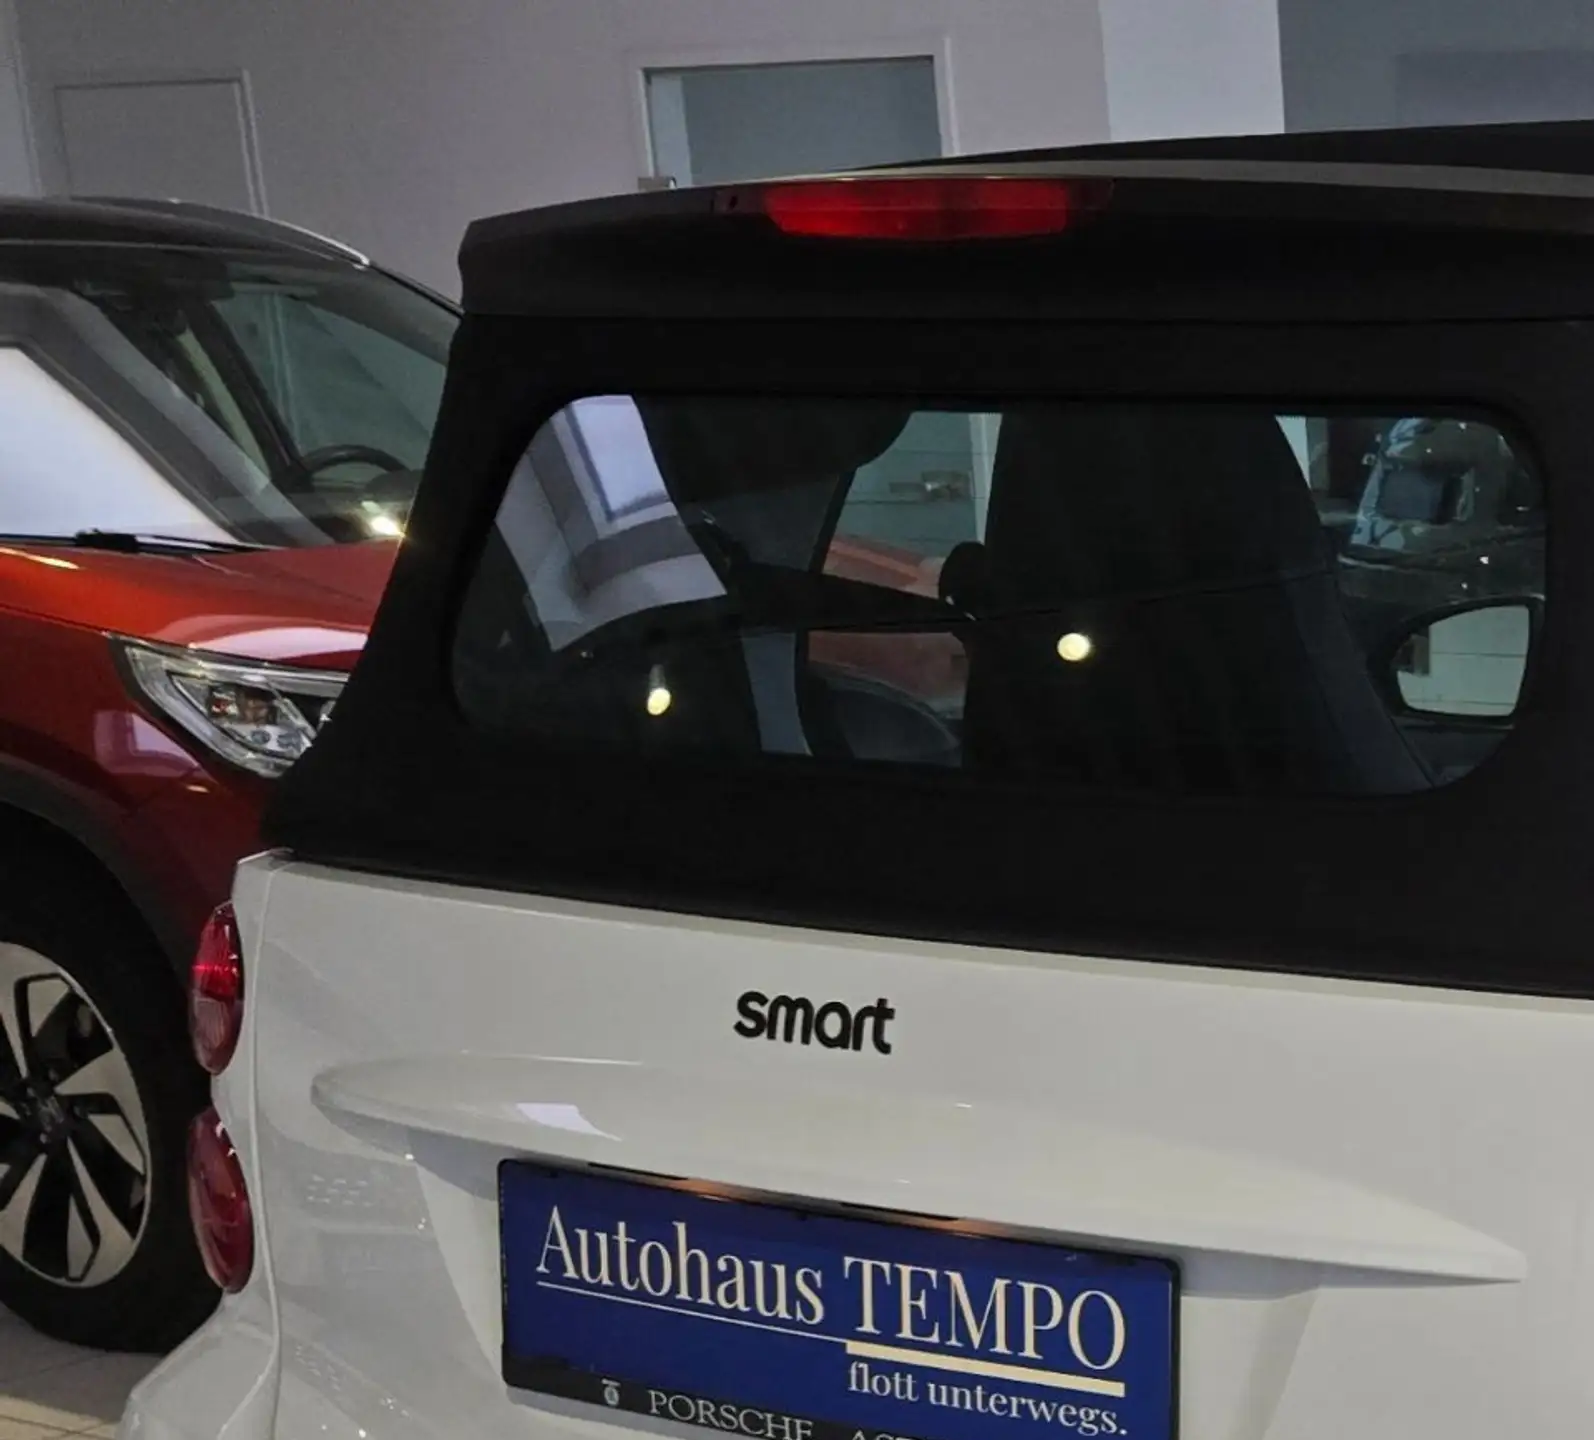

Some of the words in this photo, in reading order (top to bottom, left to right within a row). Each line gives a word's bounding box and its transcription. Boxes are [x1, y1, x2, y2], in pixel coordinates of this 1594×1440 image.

[733, 990, 896, 1055] smart
[536, 1205, 825, 1325] Autohaus
[843, 1256, 1126, 1370] TEMPO
[848, 1361, 919, 1401] flott
[926, 1381, 1128, 1437] unterwegs.
